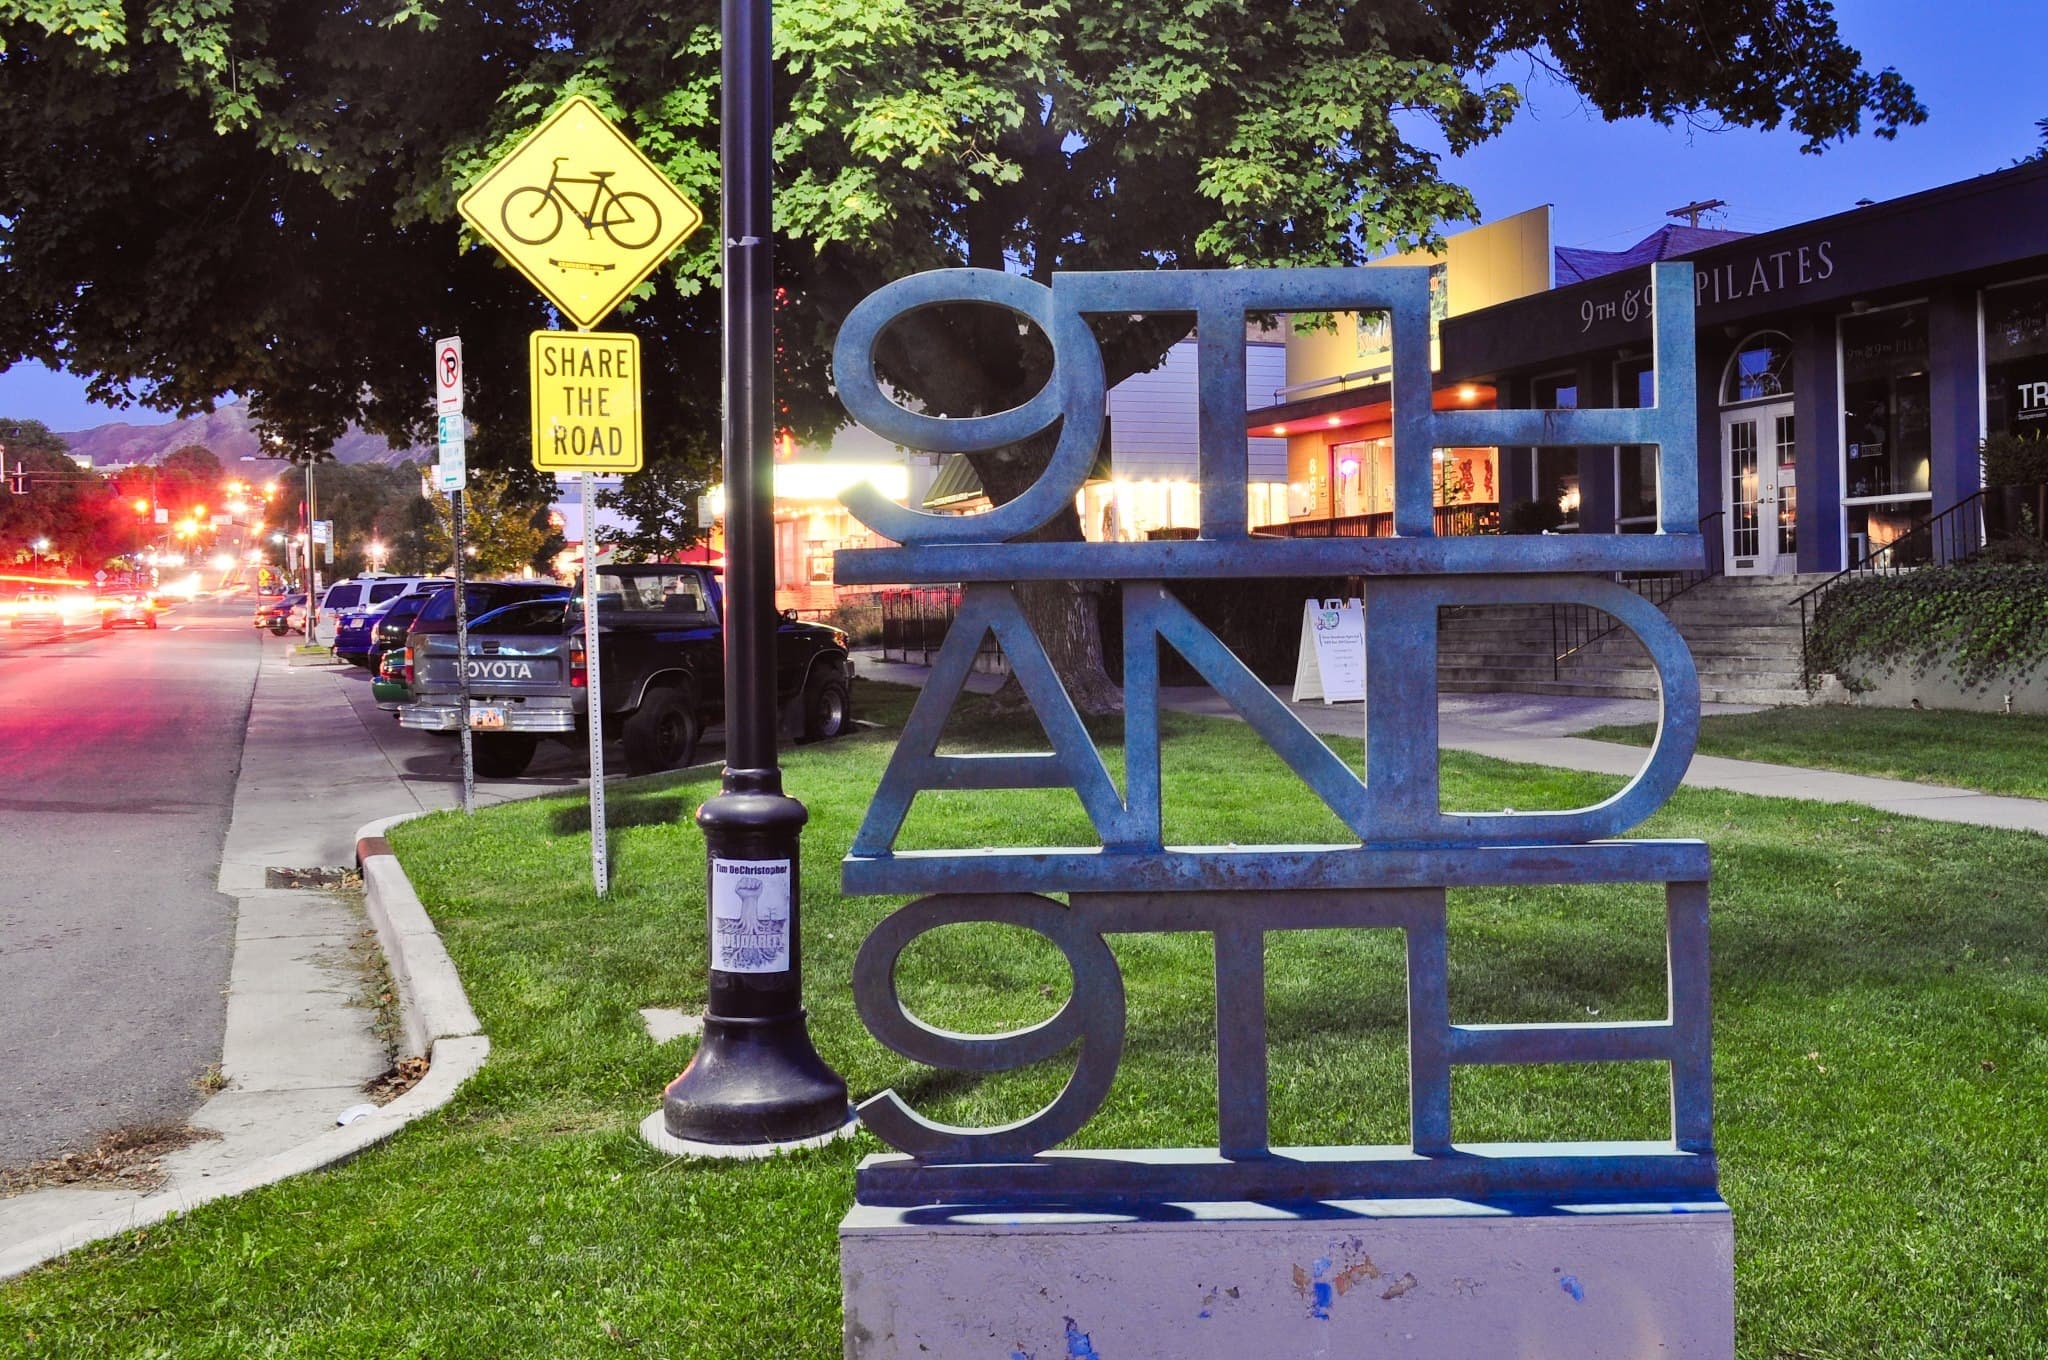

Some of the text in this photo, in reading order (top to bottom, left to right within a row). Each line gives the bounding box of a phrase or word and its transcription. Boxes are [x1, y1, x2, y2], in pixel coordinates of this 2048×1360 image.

[1580, 300, 1617, 333] 9TH
[1621, 289, 1641, 322] &
[1695, 241, 1834, 307] PILATES
[544, 346, 629, 378] SHARE
[562, 386, 610, 417] THE
[833, 262, 1698, 545] 9TH
[554, 425, 622, 456] ROAD
[452, 661, 532, 679] TOYOTA
[849, 573, 1701, 858] AND
[716, 863, 788, 876] Tim DeChristopher
[852, 882, 1713, 1164] 9TH
